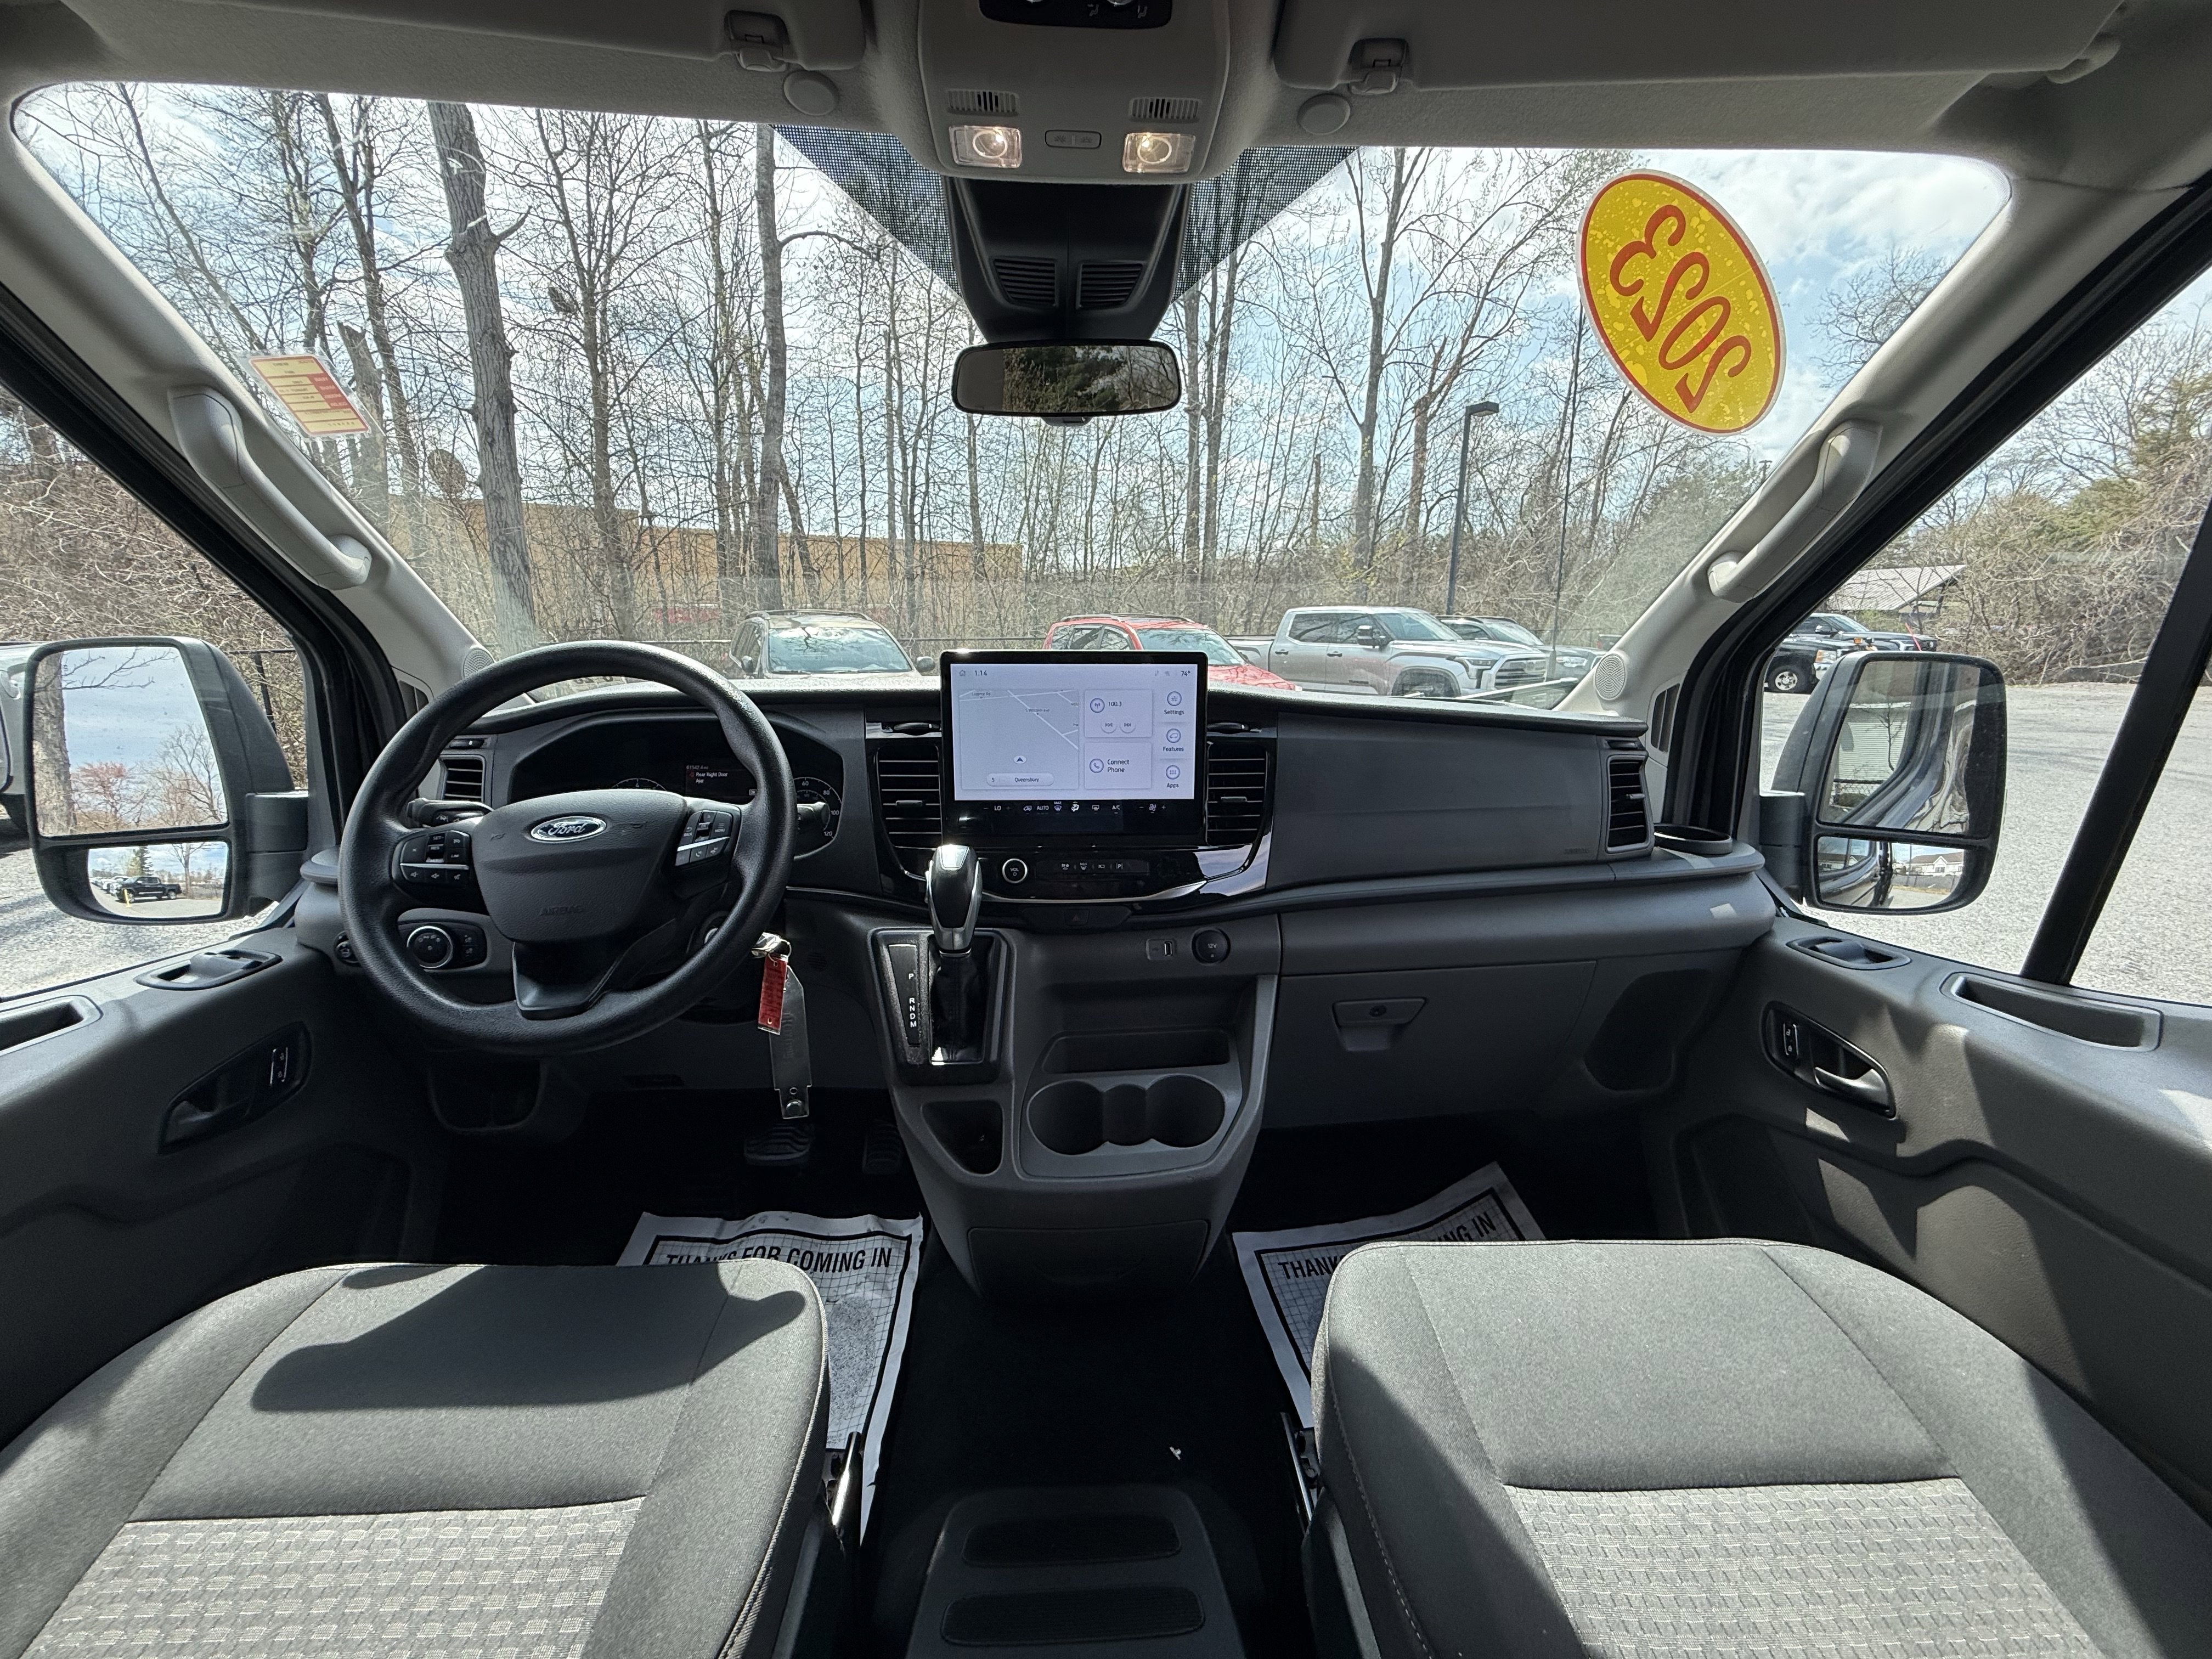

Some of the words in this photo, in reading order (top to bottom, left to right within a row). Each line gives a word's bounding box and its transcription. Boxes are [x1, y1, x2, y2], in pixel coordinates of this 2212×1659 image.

[548, 822, 586, 836] Ford
[1277, 1255, 1346, 1280] THANK
[1472, 1211, 1496, 1237] IN
[787, 1248, 866, 1273] COMING
[871, 1248, 892, 1268] IN
